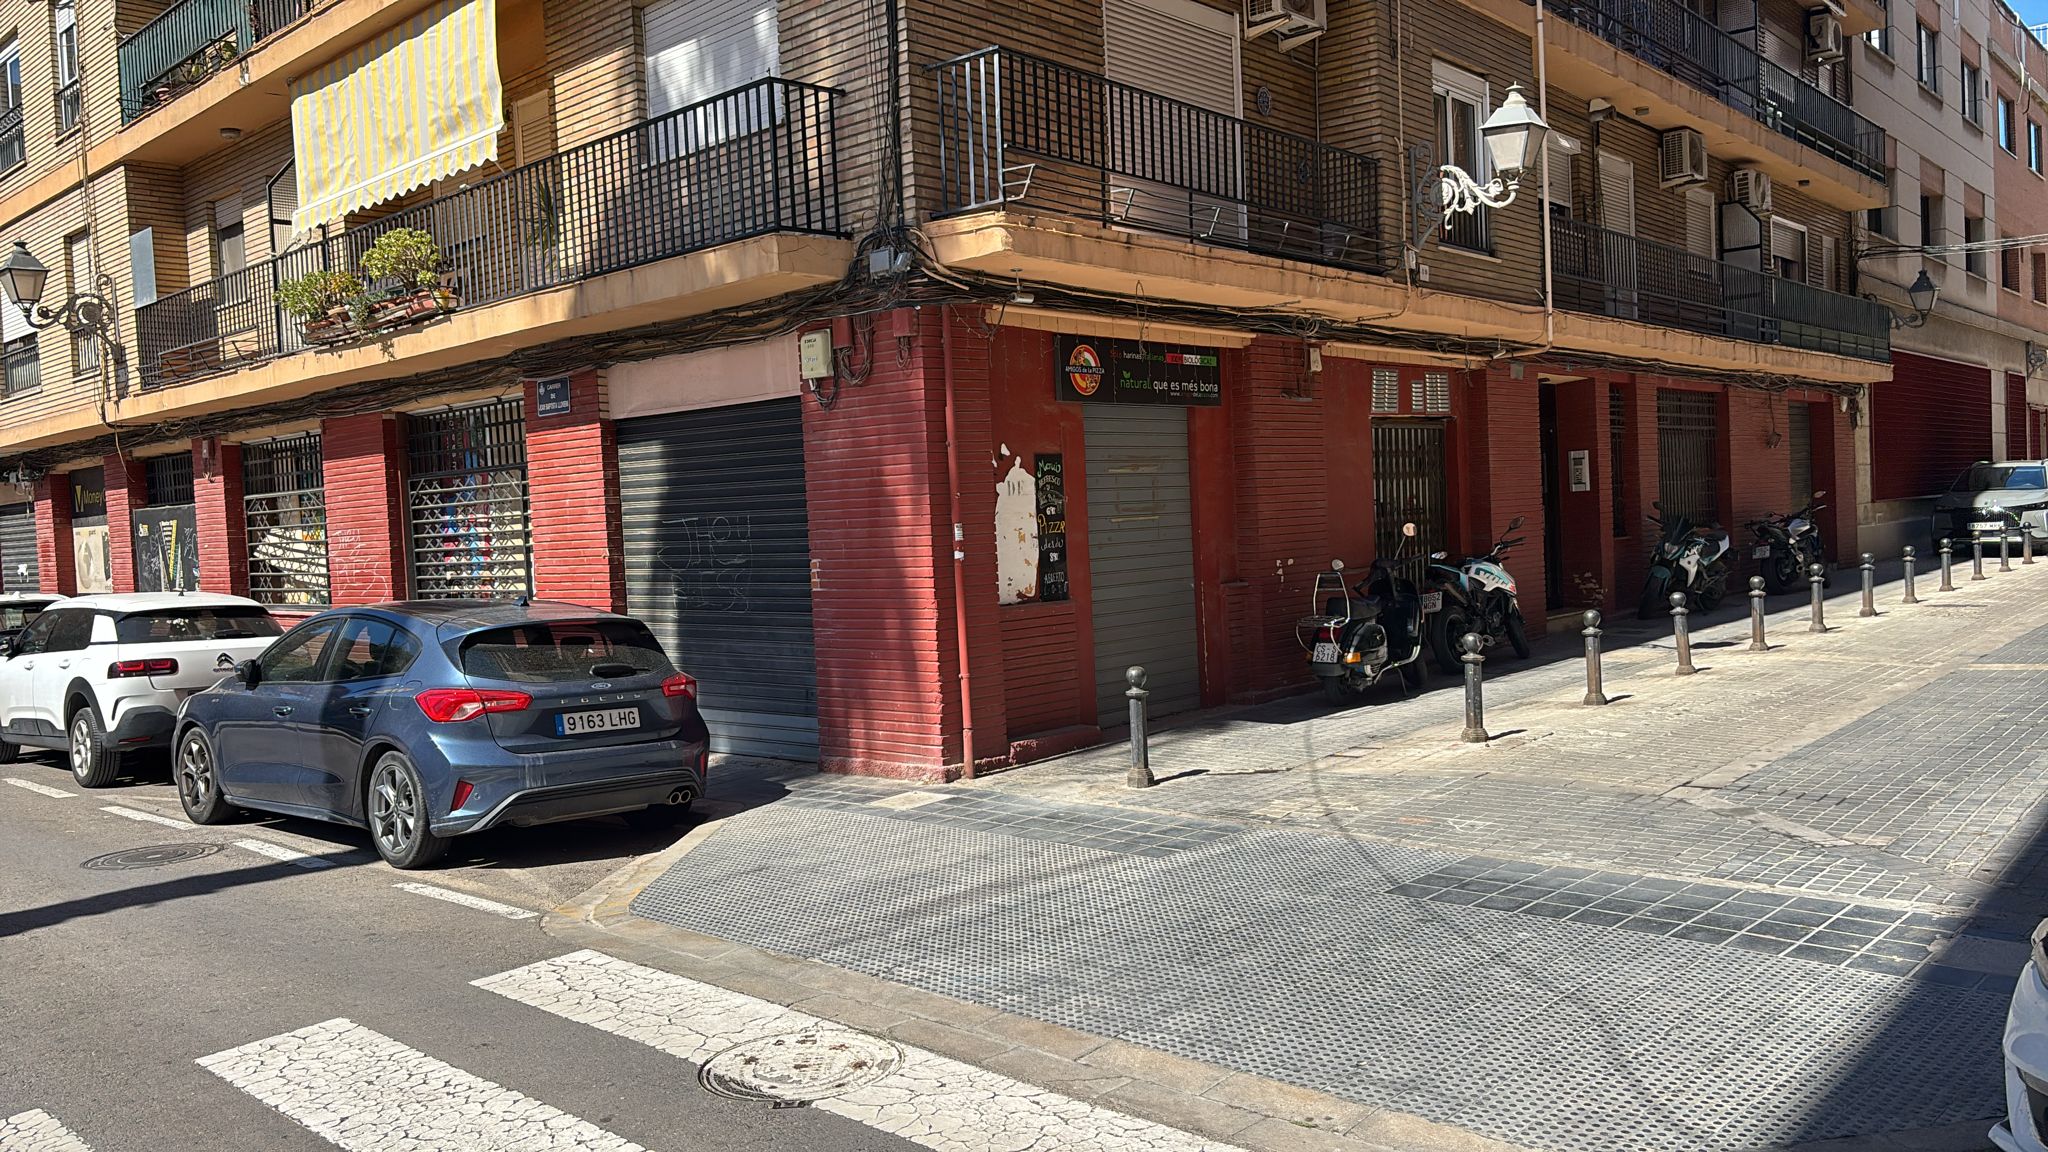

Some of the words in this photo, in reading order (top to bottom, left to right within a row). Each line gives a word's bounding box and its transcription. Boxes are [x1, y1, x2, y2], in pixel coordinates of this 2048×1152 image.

[1065, 365, 1081, 373] AMIGOS
[1092, 367, 1105, 375] PIZZA
[1153, 380, 1168, 394] que
[1170, 382, 1180, 391] es
[1182, 379, 1198, 392] més
[1200, 379, 1218, 393] bona
[1316, 653, 1335, 661] 6218
[567, 713, 605, 731] 9163
[609, 711, 636, 727] LHG
